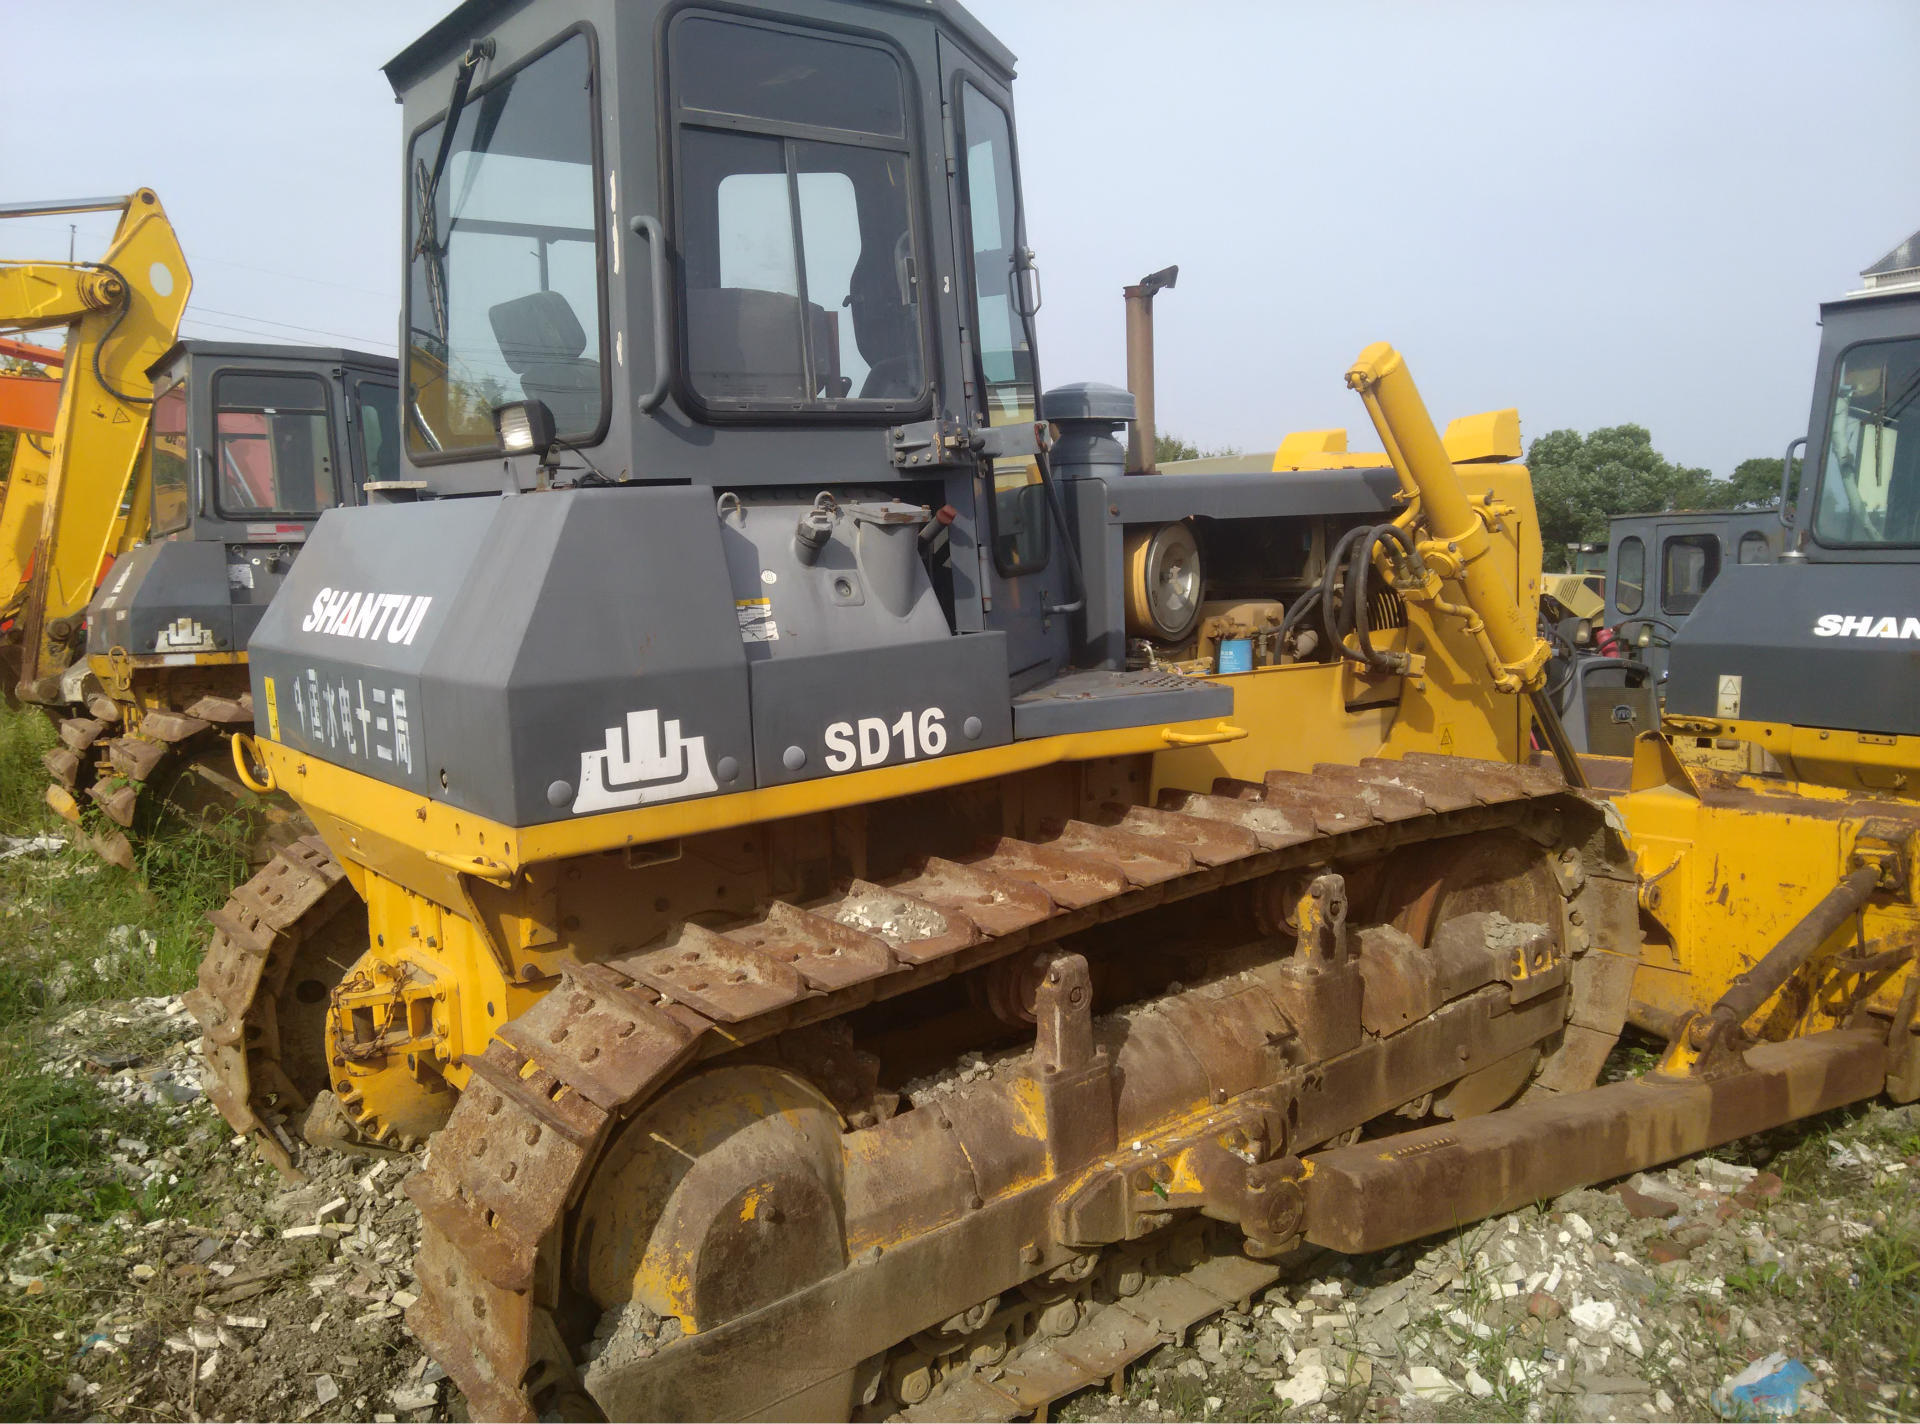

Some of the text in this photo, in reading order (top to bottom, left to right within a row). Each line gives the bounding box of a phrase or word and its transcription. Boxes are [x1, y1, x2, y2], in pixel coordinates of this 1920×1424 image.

[302, 587, 433, 645] SHANTUI
[293, 668, 412, 775] 中国水电十三局
[824, 707, 947, 772] SD16
